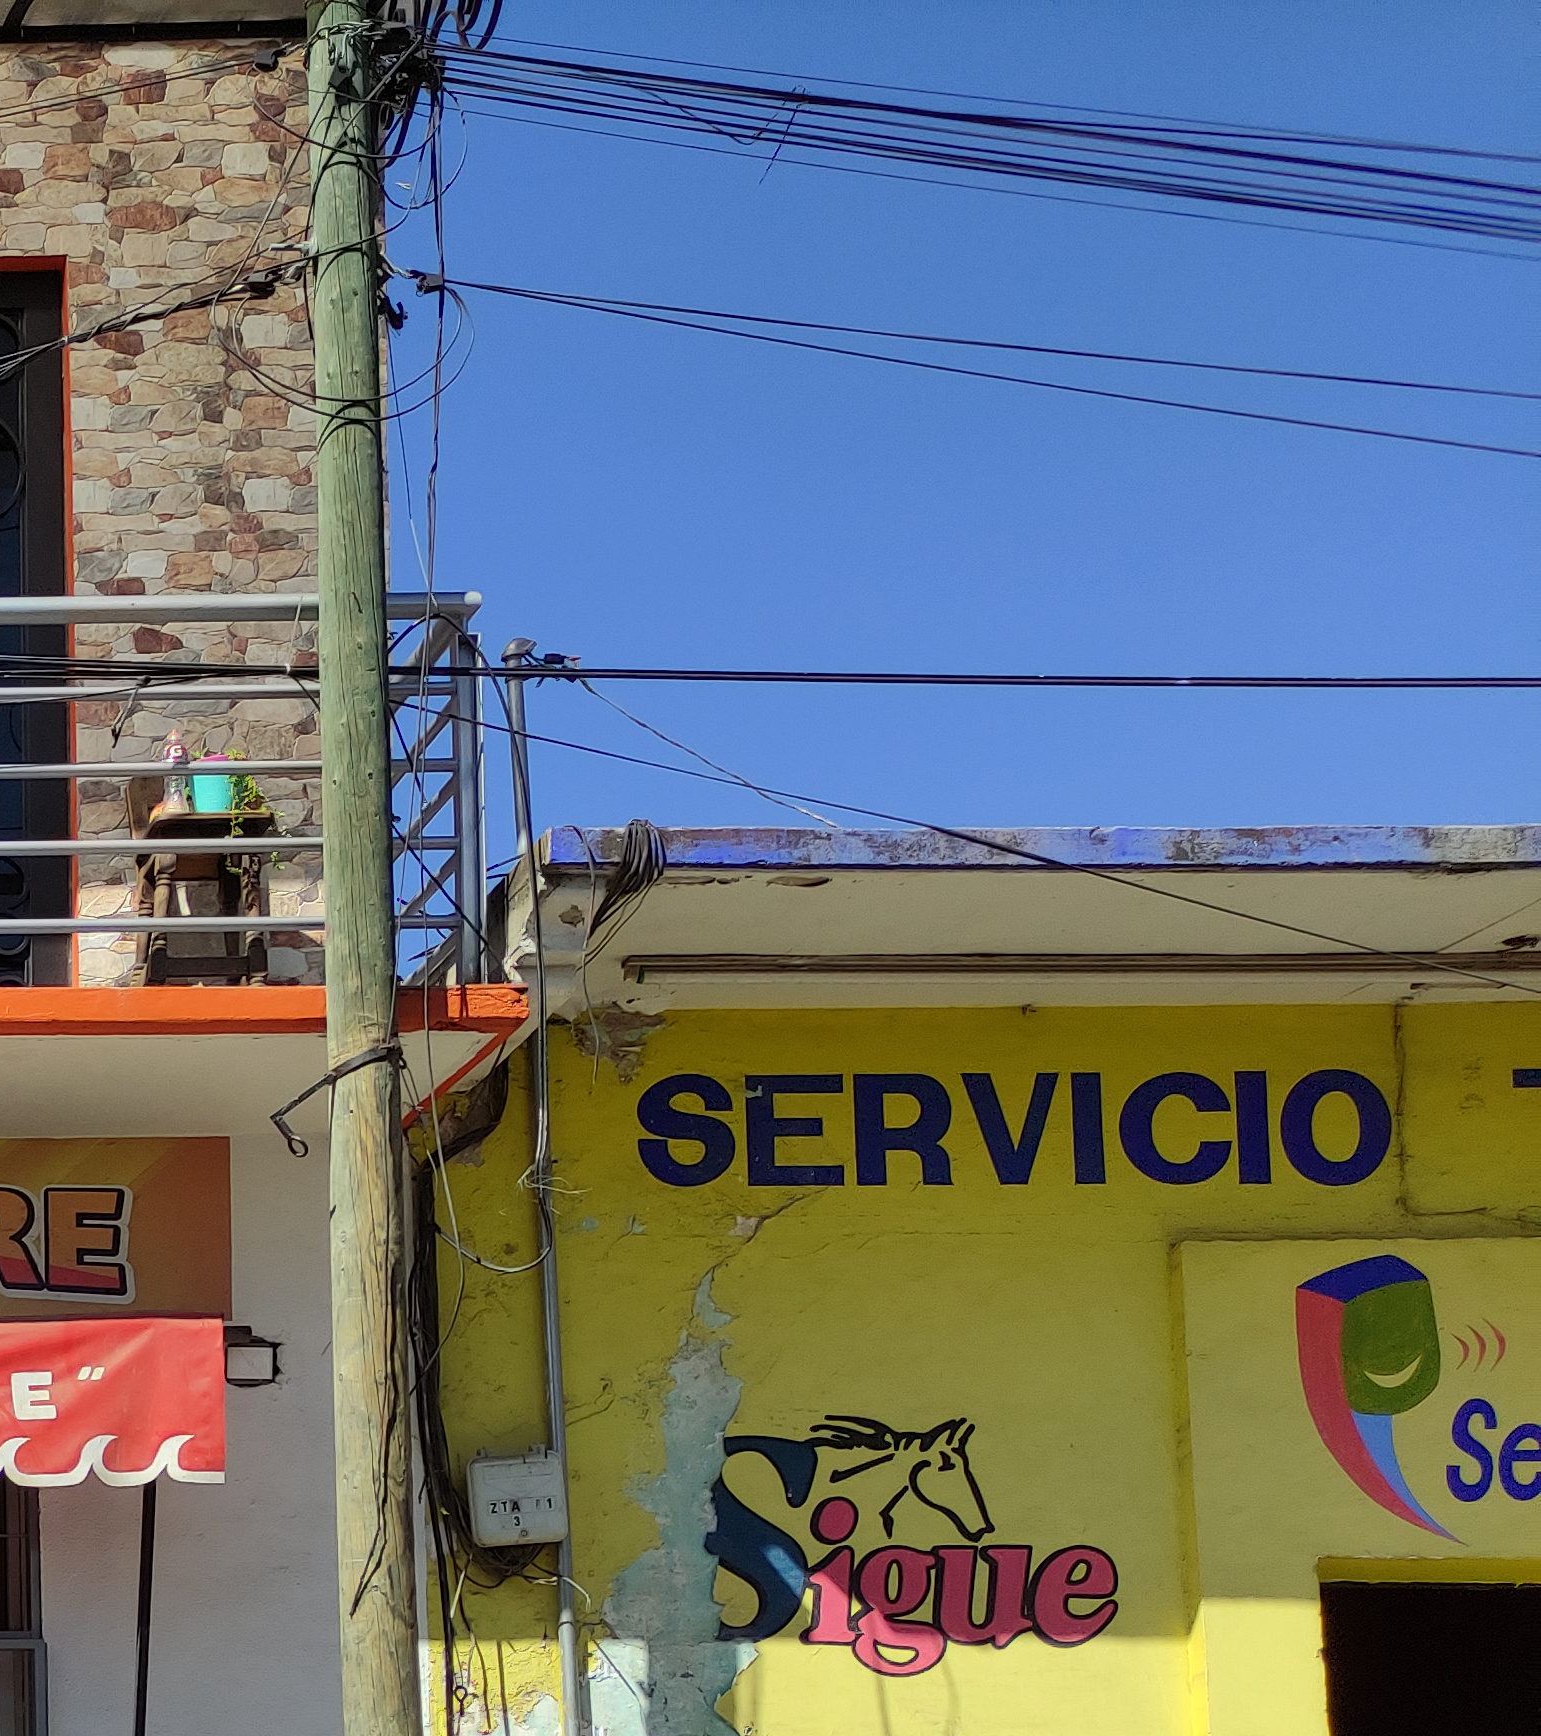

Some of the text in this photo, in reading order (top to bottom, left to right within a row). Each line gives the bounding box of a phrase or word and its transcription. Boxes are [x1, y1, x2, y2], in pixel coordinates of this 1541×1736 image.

[636, 1068, 1392, 1187] SERVICIO
[514, 1516, 520, 1527] 3
[705, 1436, 1119, 1678] Sigue
